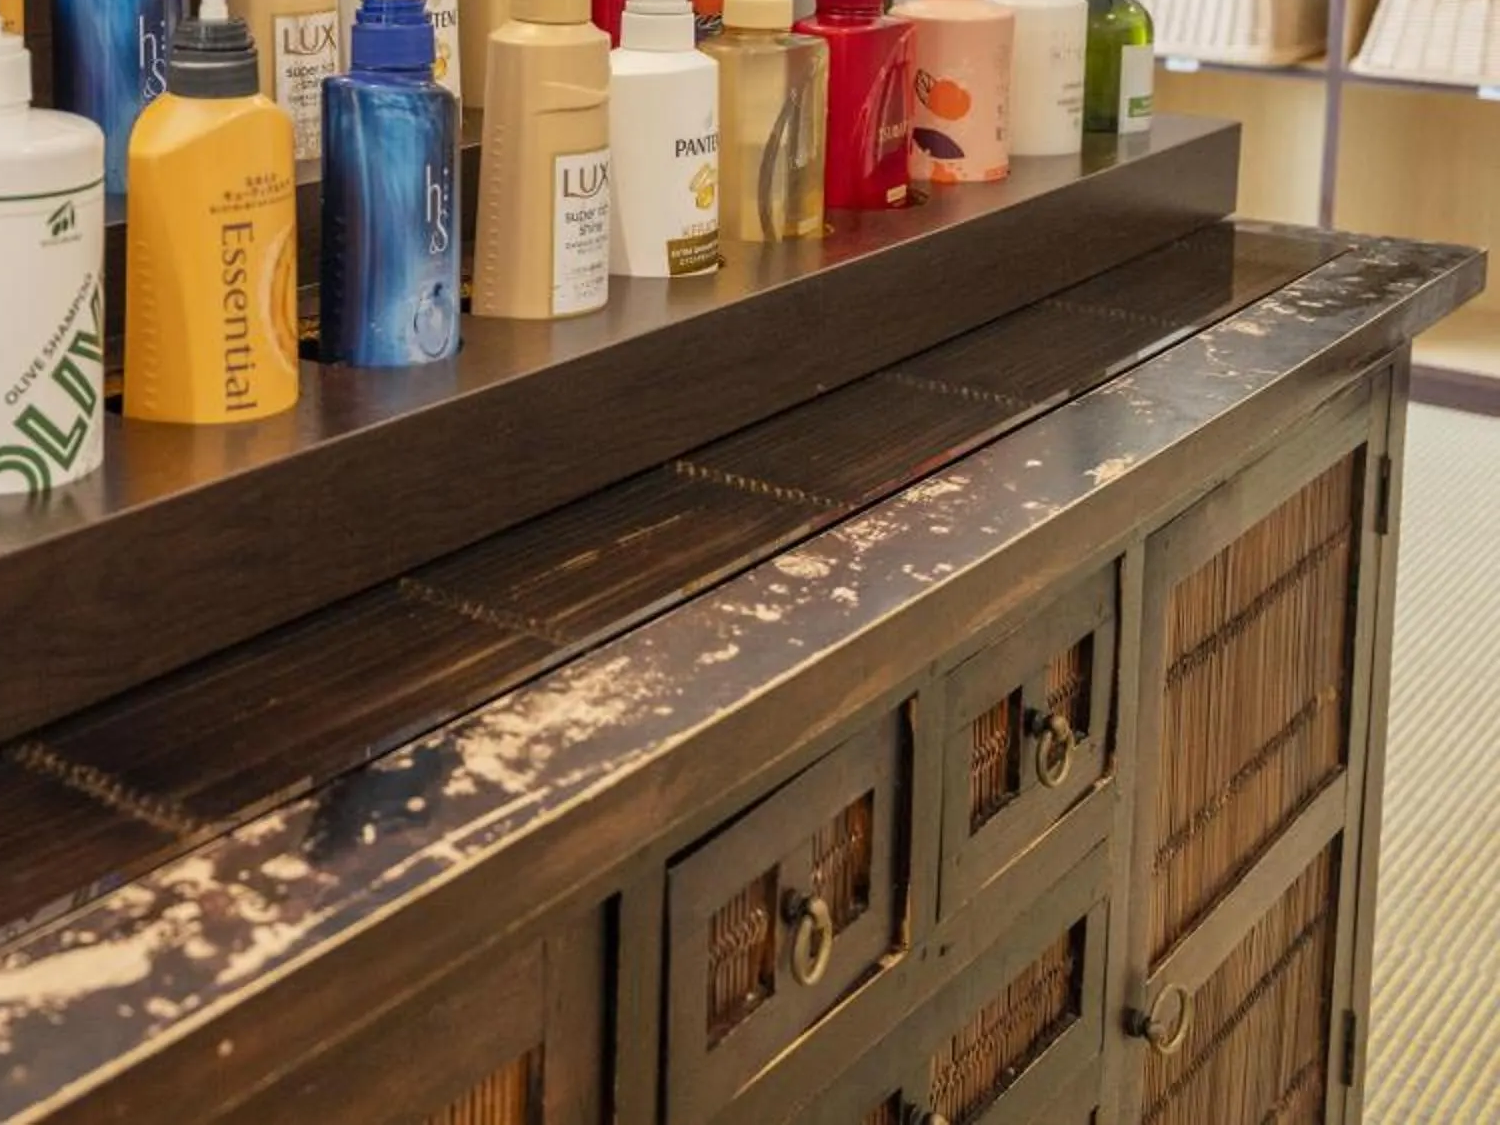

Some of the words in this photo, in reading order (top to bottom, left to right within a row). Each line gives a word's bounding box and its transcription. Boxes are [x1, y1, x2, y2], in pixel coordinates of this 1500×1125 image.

[283, 22, 337, 55] LUX
[563, 162, 609, 198] LUX
[220, 220, 258, 413] Essential
[3, 357, 47, 406] OLIVE
